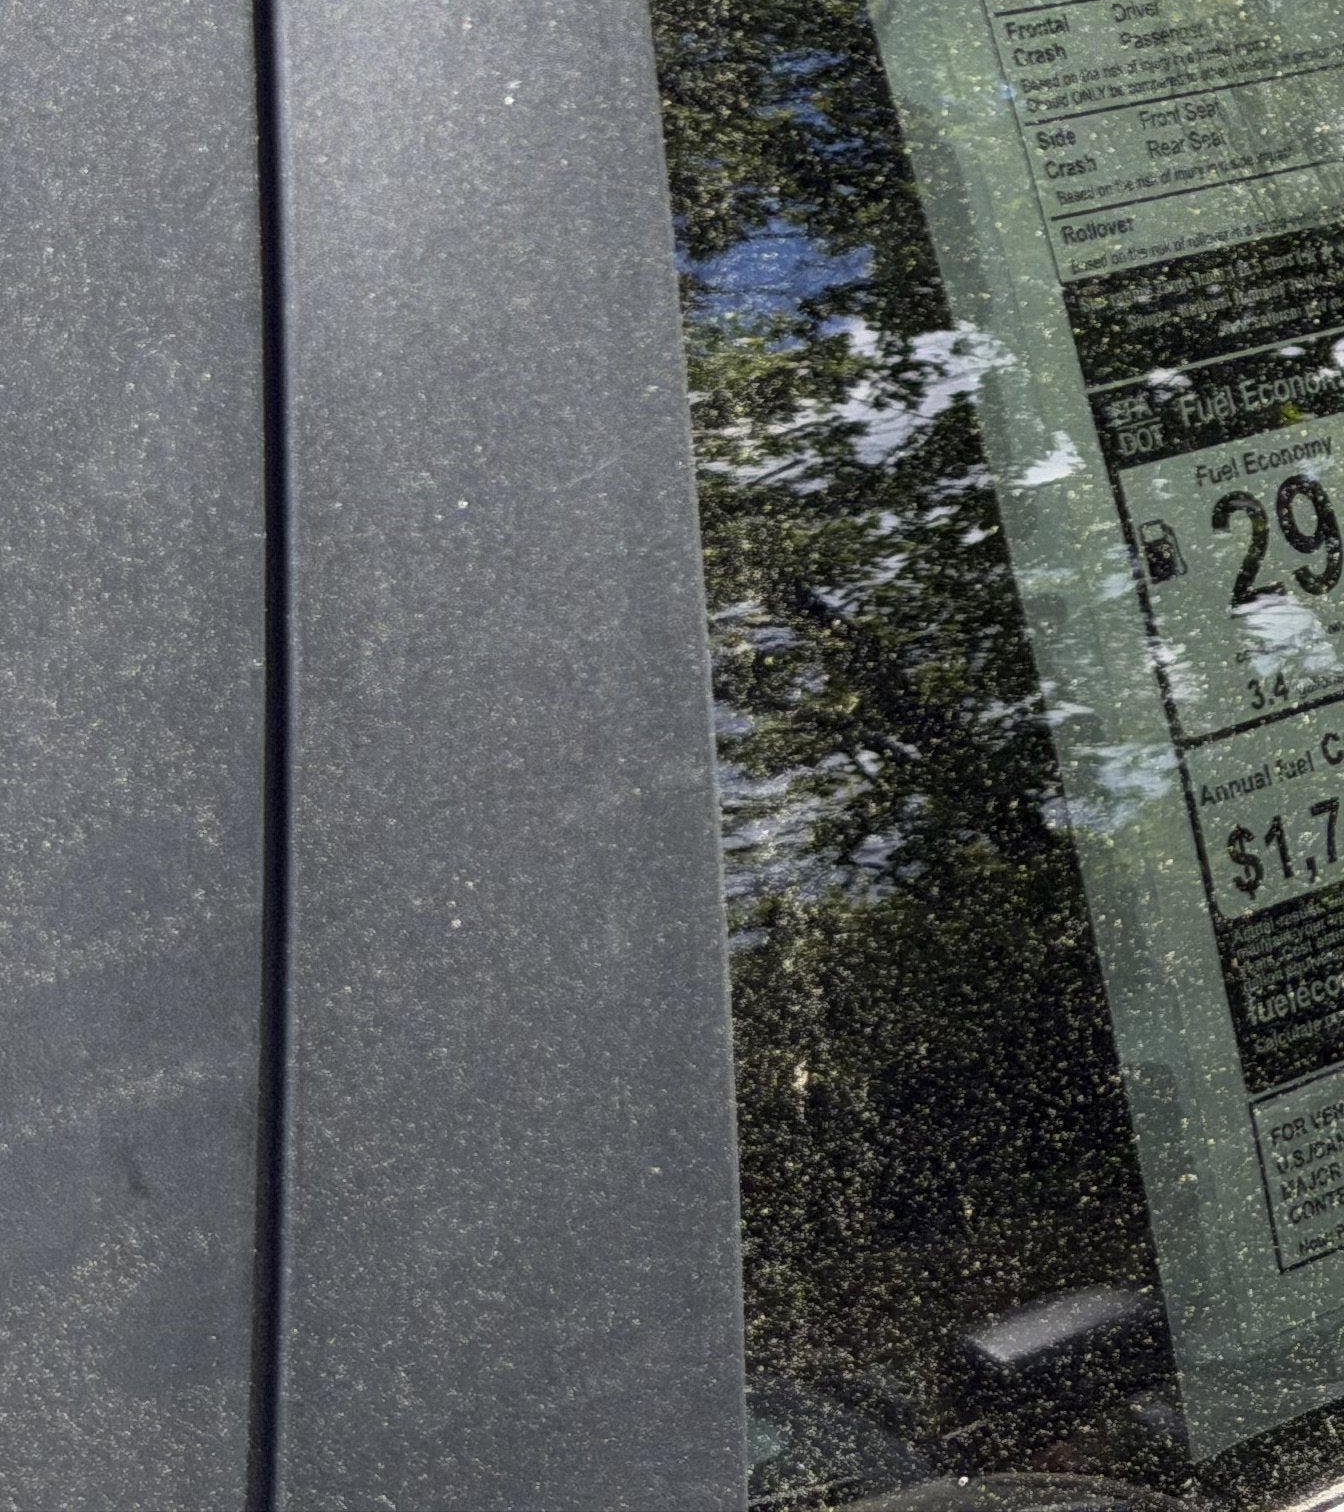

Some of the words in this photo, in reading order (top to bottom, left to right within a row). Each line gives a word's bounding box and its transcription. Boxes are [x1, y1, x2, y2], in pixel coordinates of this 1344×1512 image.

[1005, 14, 1070, 42] Frontal
[1012, 42, 1067, 68] Crash
[1138, 106, 1182, 130] Front
[1183, 97, 1223, 121] Seat
[1036, 127, 1078, 151] Side
[1148, 136, 1188, 159] Rear
[1188, 128, 1227, 151] Seat
[1044, 154, 1098, 180] Crash
[1060, 213, 1136, 246] Rollover
[1179, 391, 1237, 426] Fuel
[1120, 423, 1169, 457] DOT
[1195, 457, 1241, 489] Fuel
[1241, 432, 1334, 476] Economy
[1246, 669, 1290, 713] 3.4
[1197, 766, 1273, 809] Annual
[1275, 749, 1315, 783] fuel
[1269, 1117, 1308, 1154] FOR
